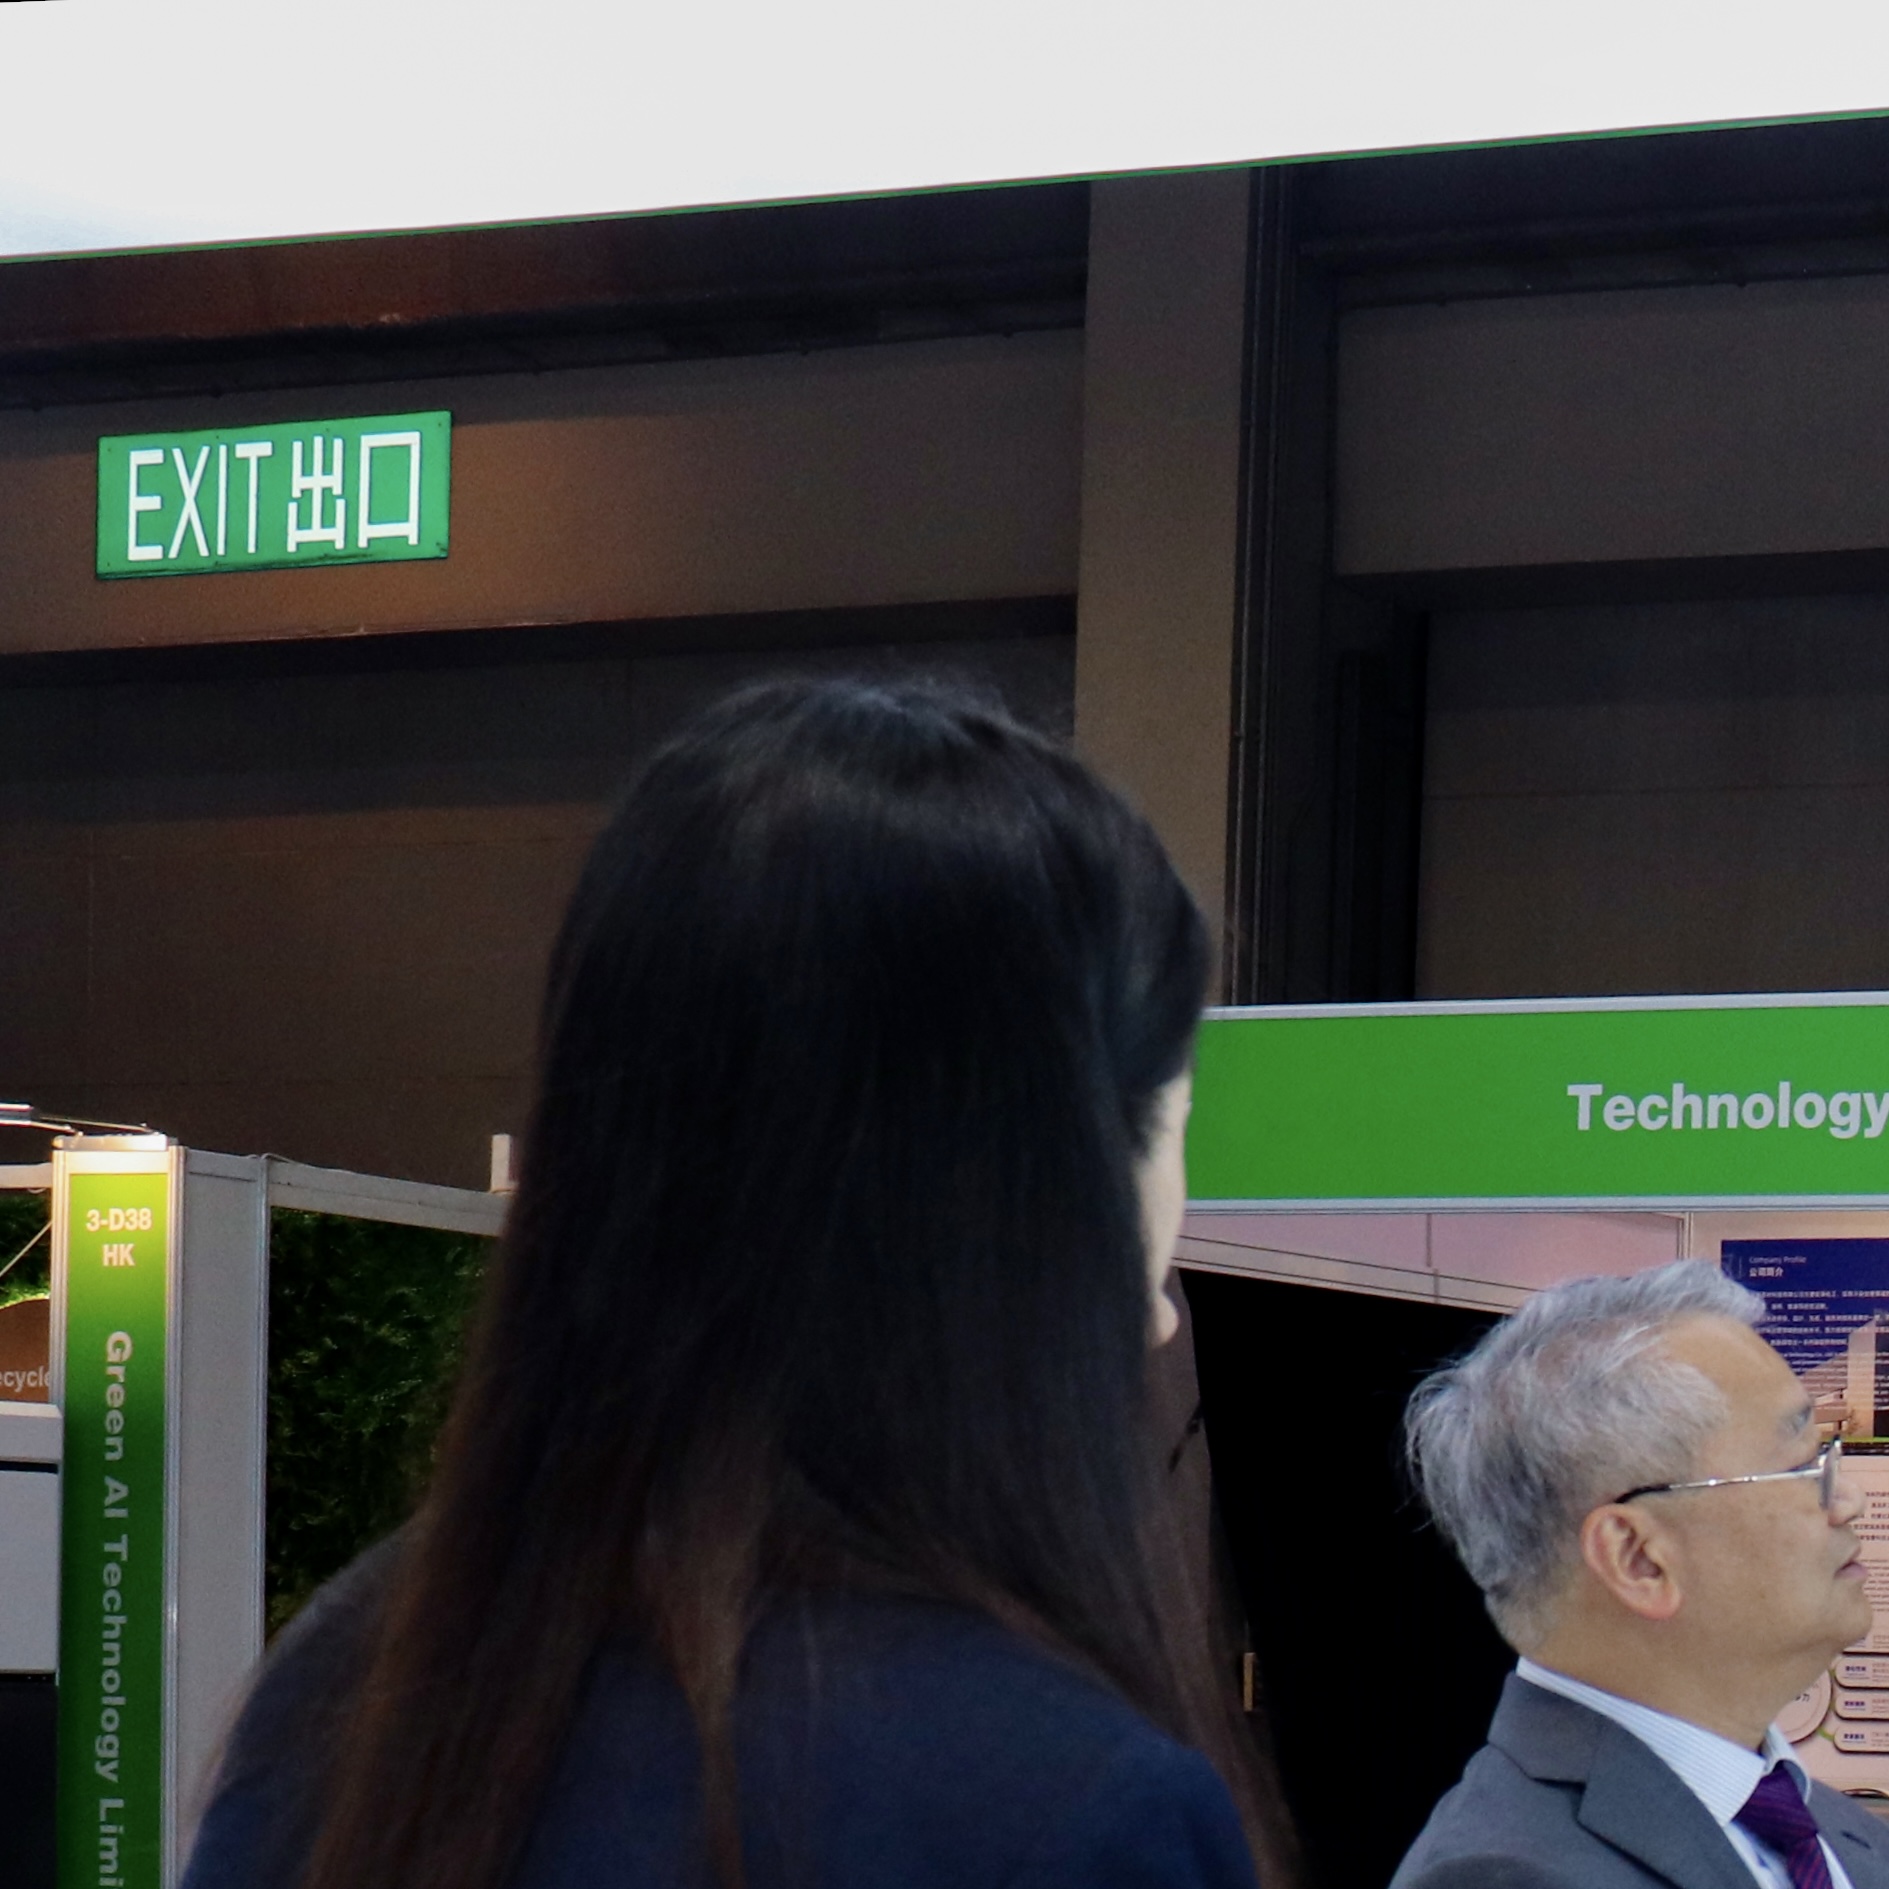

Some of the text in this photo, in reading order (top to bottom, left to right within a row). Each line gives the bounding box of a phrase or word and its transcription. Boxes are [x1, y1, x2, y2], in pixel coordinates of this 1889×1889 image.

[127, 430, 422, 562] EXIT 出口
[86, 1207, 152, 1231] 3-D38
[103, 1244, 135, 1266] HK
[104, 1330, 134, 1462] Green
[104, 1477, 130, 1519] AI
[94, 1533, 130, 1783] Technology
